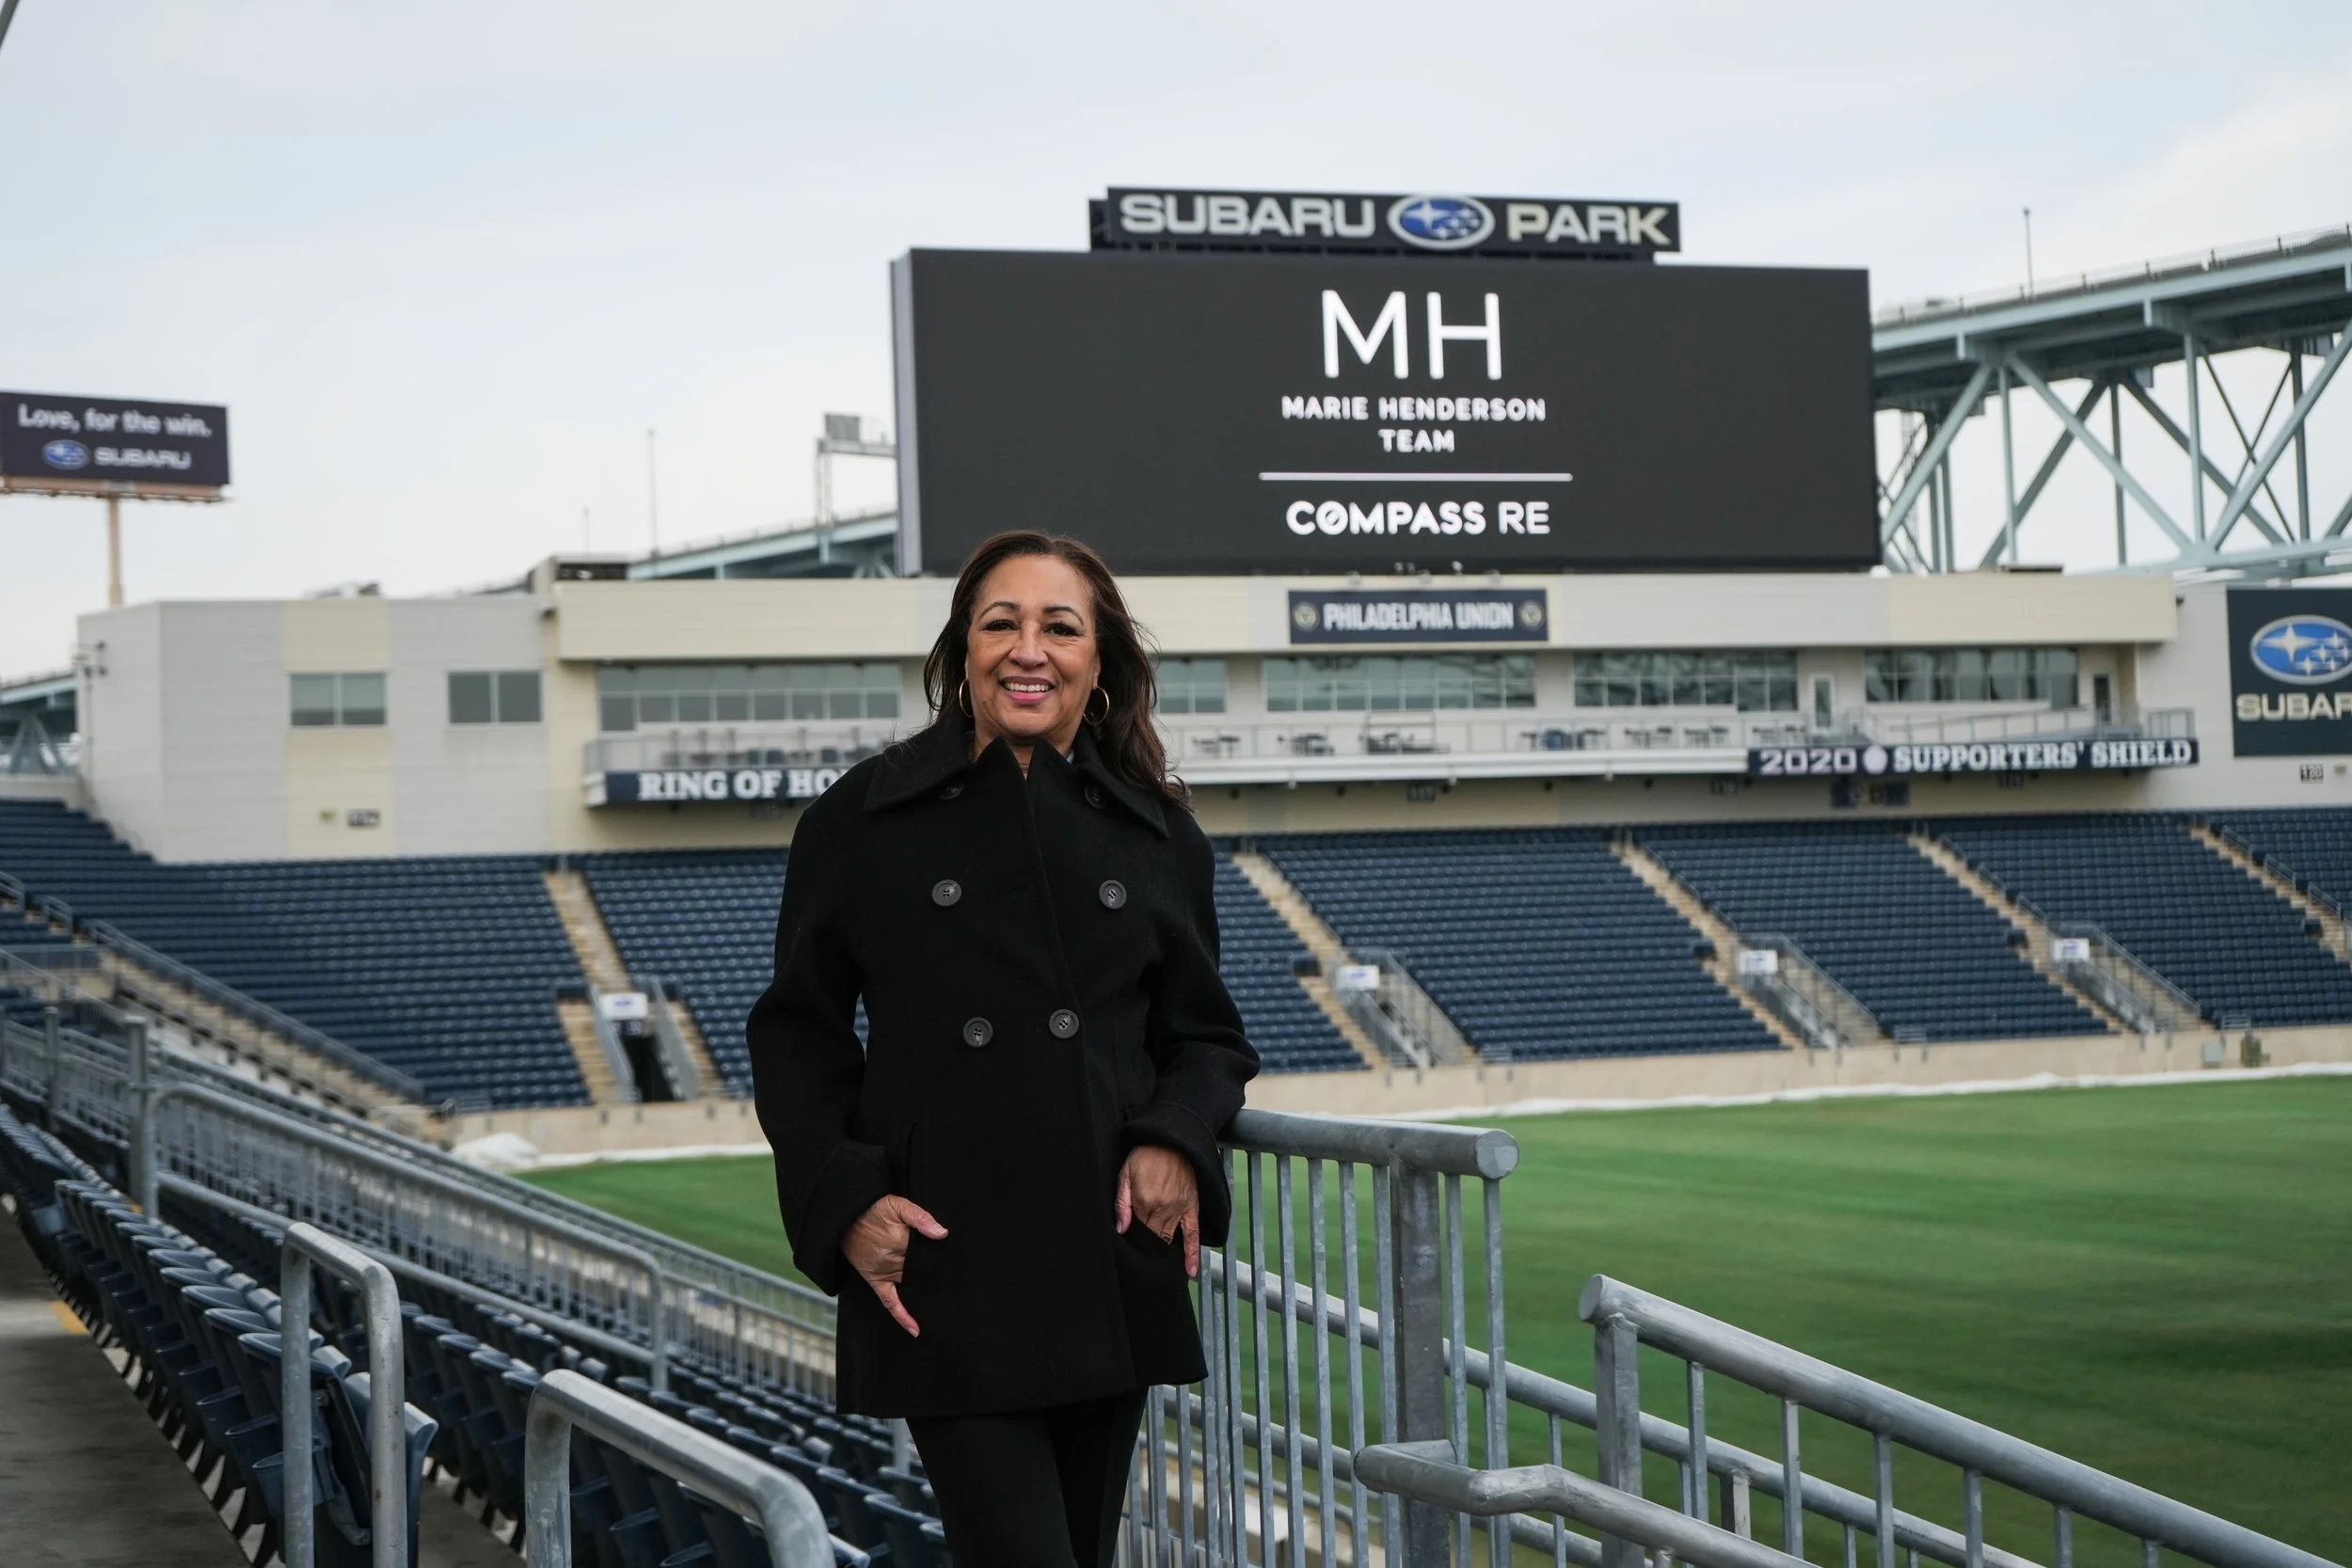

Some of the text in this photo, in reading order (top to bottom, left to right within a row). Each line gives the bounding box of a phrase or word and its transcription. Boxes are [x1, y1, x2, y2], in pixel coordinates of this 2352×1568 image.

[1120, 194, 1671, 246] SUBARU PARK
[1322, 290, 1502, 380] MH
[18, 404, 212, 437] Love, for the win.
[1281, 395, 1547, 421] MARIE HENDERSON
[1378, 428, 1455, 453] TEAM
[94, 446, 191, 469] SUBARU
[1286, 500, 1550, 535] COMPASS RE
[1323, 601, 1514, 631] PHILADELPHIA UNION
[1759, 737, 2193, 775] 2020 SUPPORTERS' SHIELD
[637, 768, 849, 800] RING OF HO
